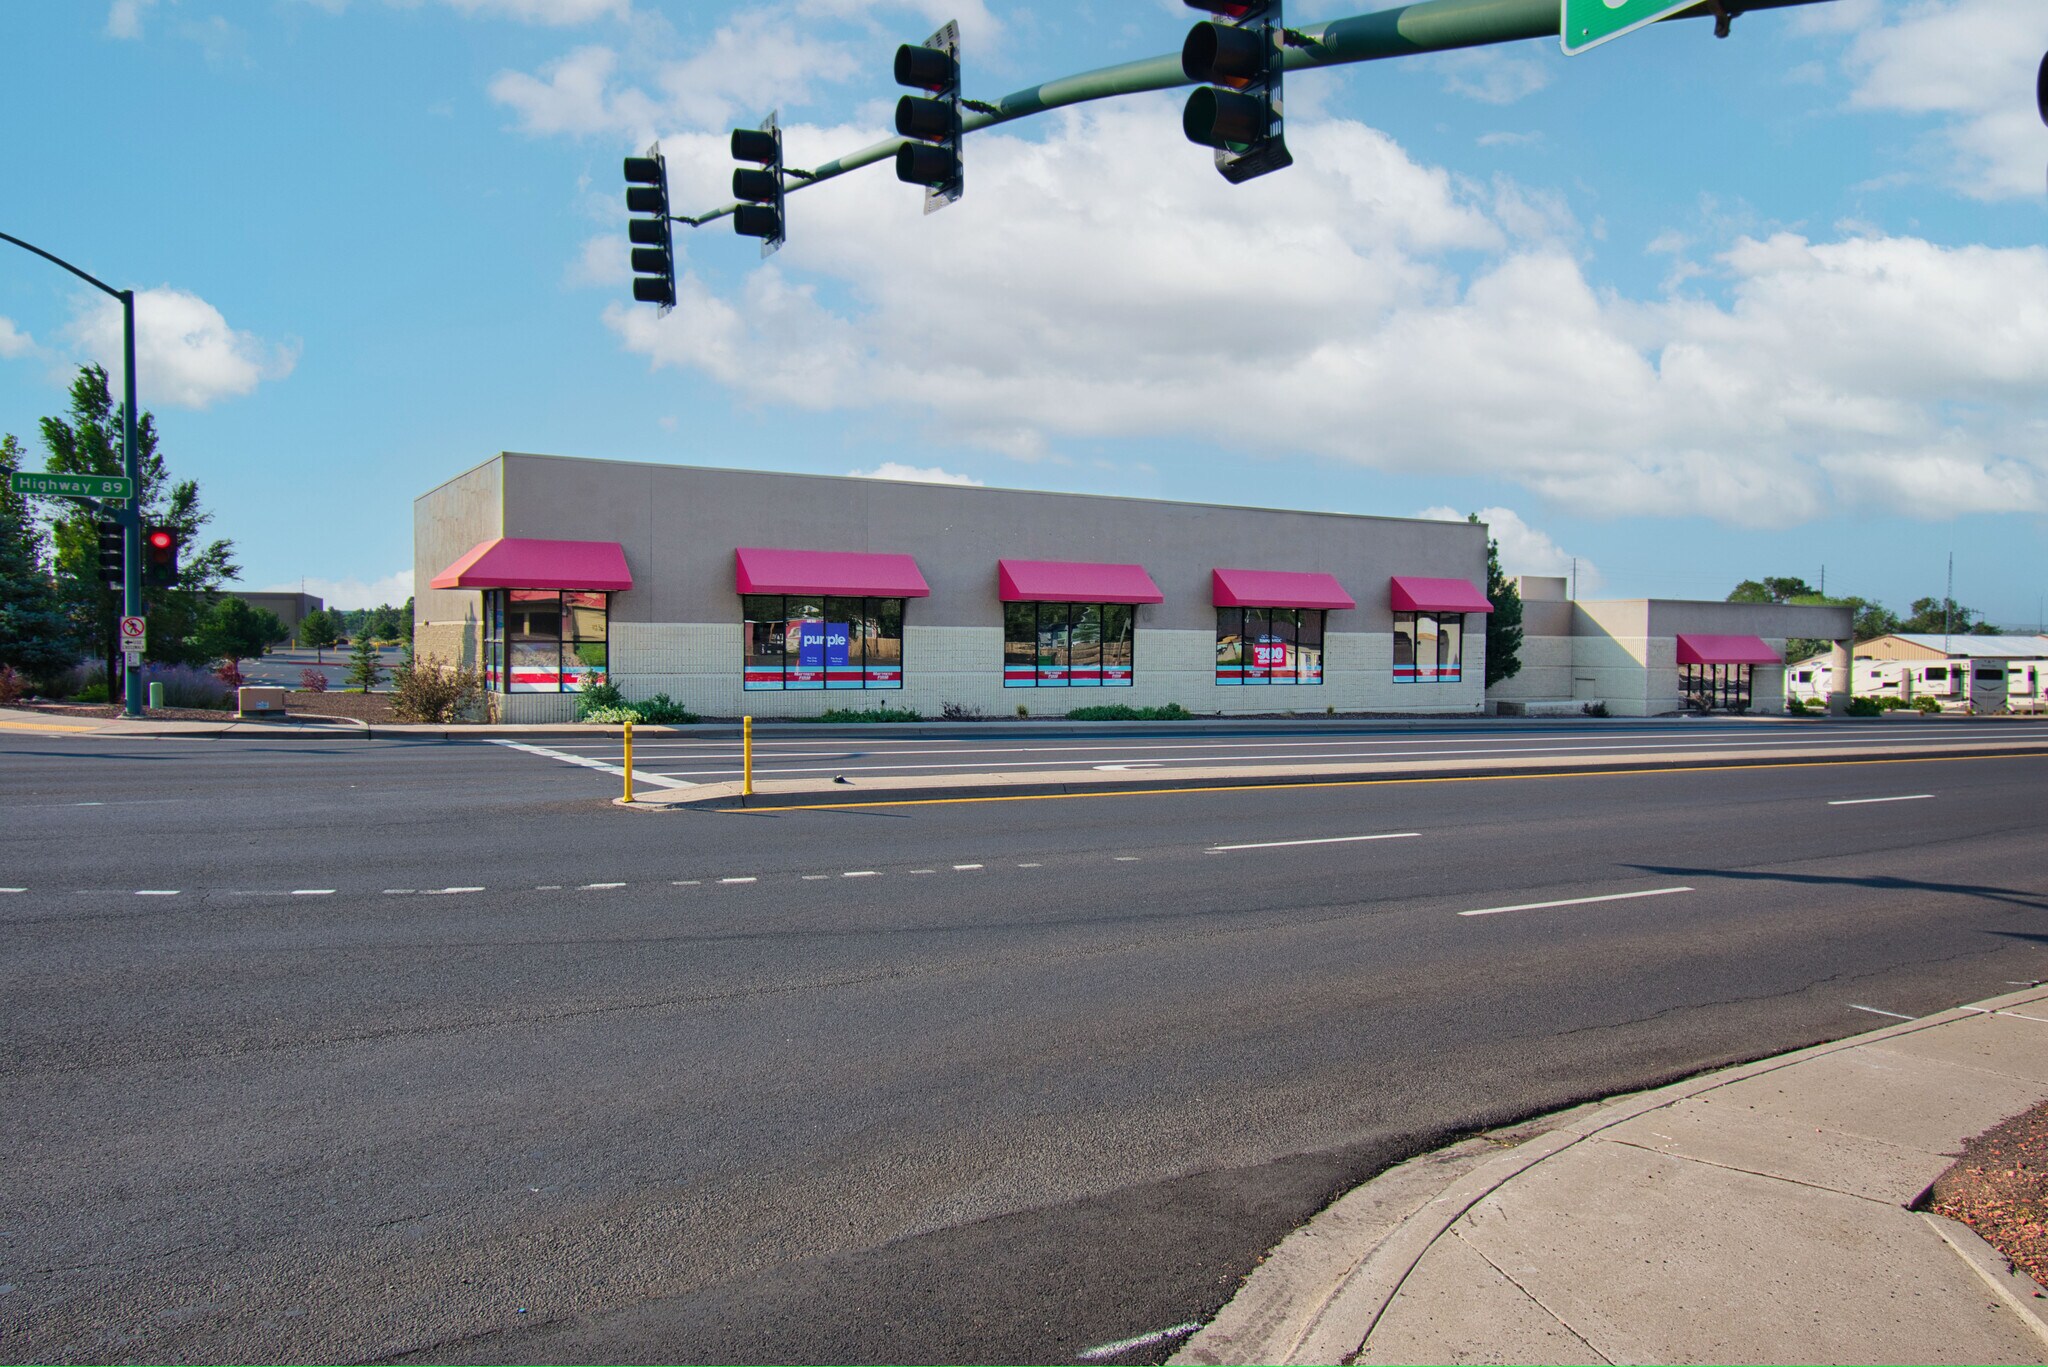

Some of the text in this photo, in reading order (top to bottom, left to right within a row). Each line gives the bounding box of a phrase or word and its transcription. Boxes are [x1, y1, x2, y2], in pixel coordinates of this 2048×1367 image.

[20, 478, 122, 494] Highway 89
[803, 633, 846, 647] purple
